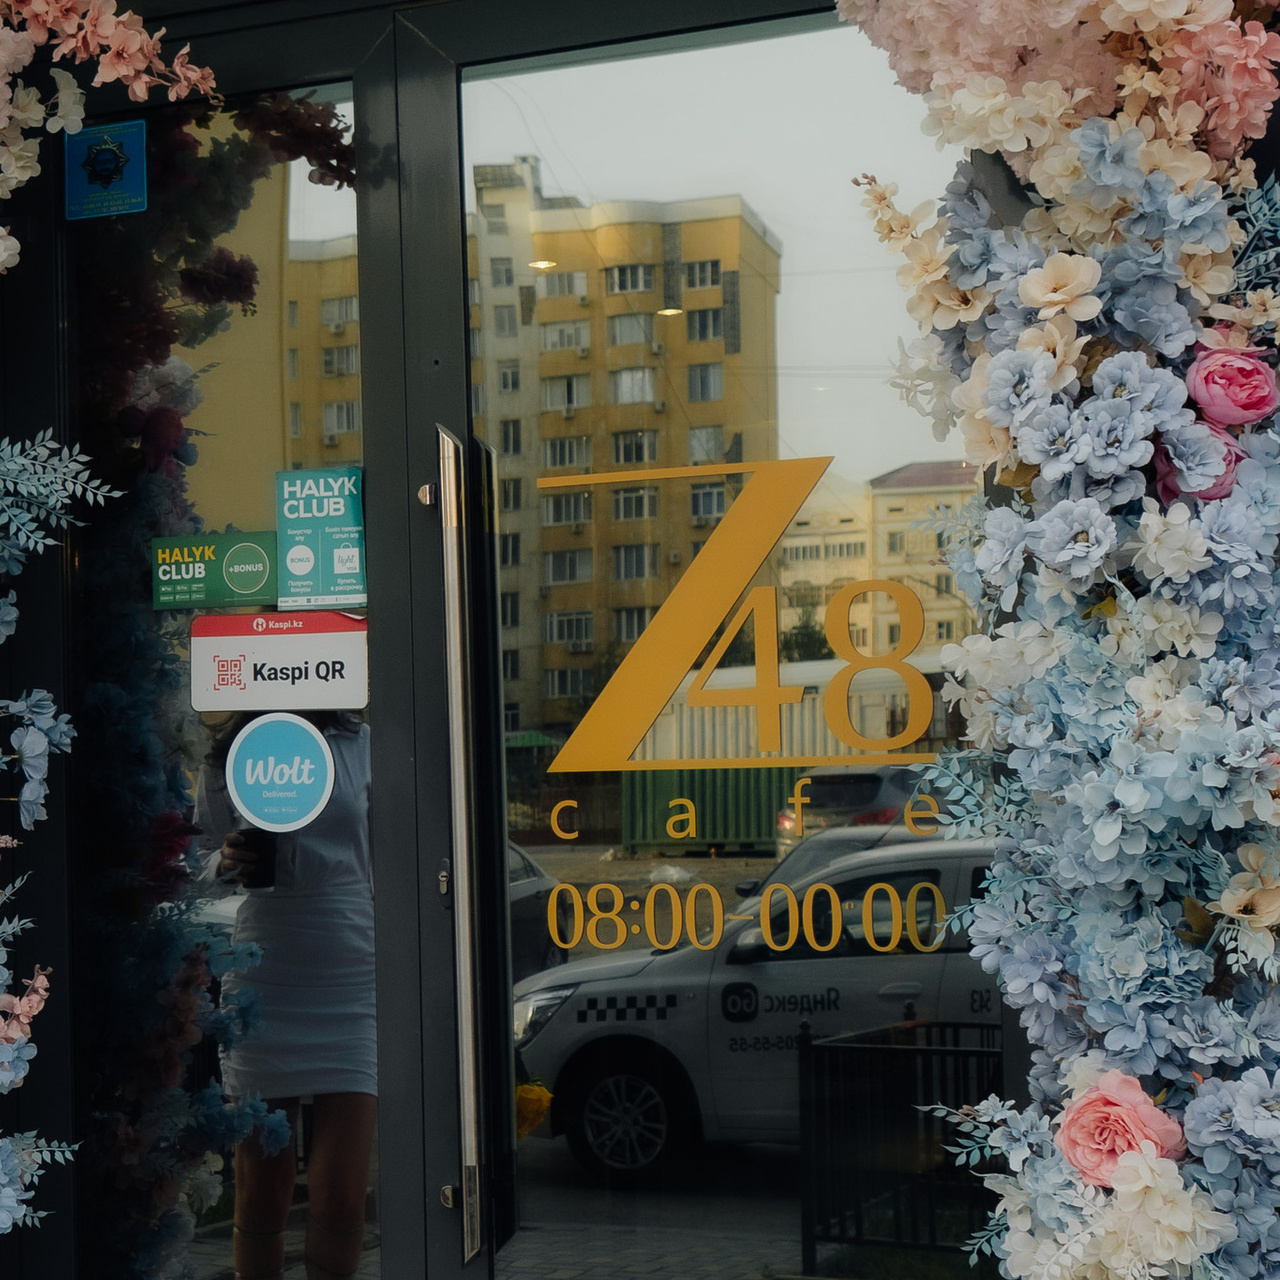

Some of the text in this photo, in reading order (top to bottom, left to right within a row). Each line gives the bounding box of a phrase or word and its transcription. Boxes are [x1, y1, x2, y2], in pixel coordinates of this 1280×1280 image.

[284, 476, 357, 499] HALYK
[284, 497, 345, 519] CLUB
[157, 545, 216, 563] HALYK
[158, 563, 206, 580] CLUB
[229, 564, 264, 573] +BONUS
[268, 620, 303, 630] Kaspi.kz
[253, 661, 345, 685] Kaspi QR
[245, 756, 315, 785] Wolt
